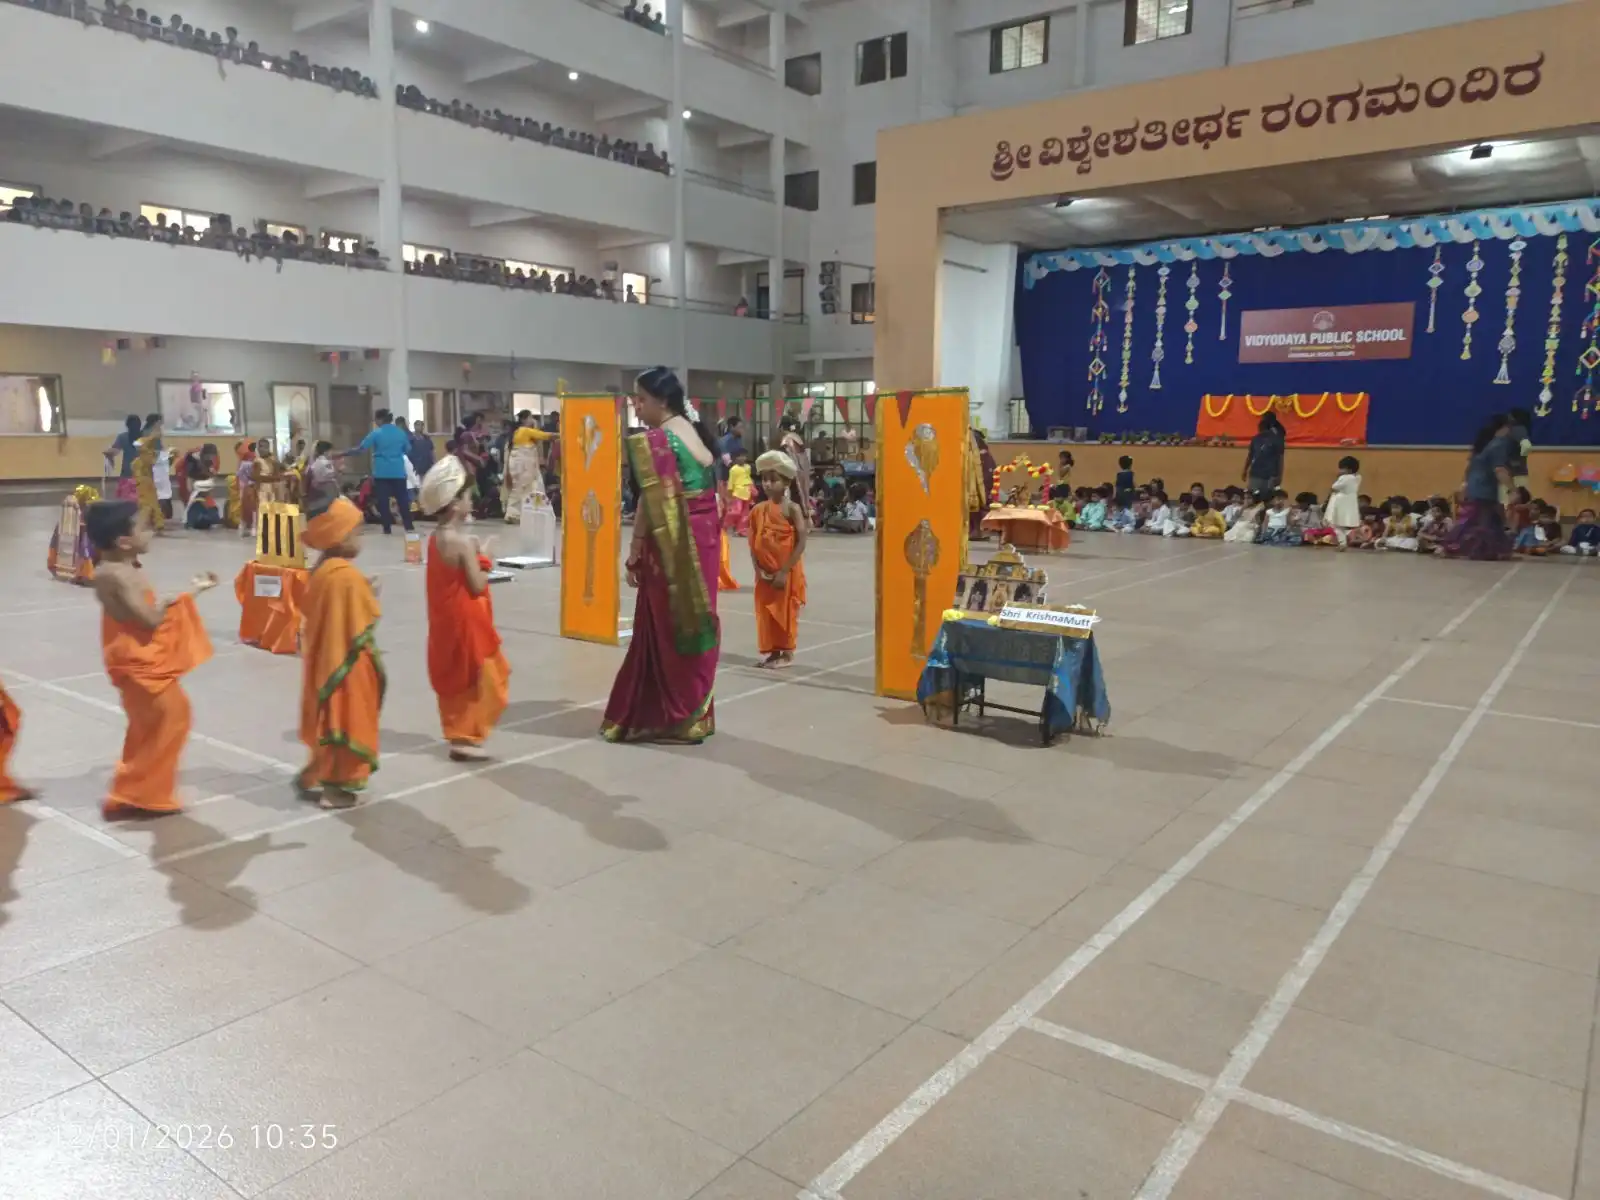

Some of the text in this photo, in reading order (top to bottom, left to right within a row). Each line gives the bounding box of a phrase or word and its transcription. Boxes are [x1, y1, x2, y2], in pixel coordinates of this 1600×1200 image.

[990, 51, 1545, 181] ಶ್ರೀ ವಿಶ್ವೇಶತೀರ್ಥ ರಂಗಮಂದಿರ
[1245, 328, 1407, 347] VIDYODAYA PUBLIC SCHOOL
[1002, 609, 1021, 618] Shri
